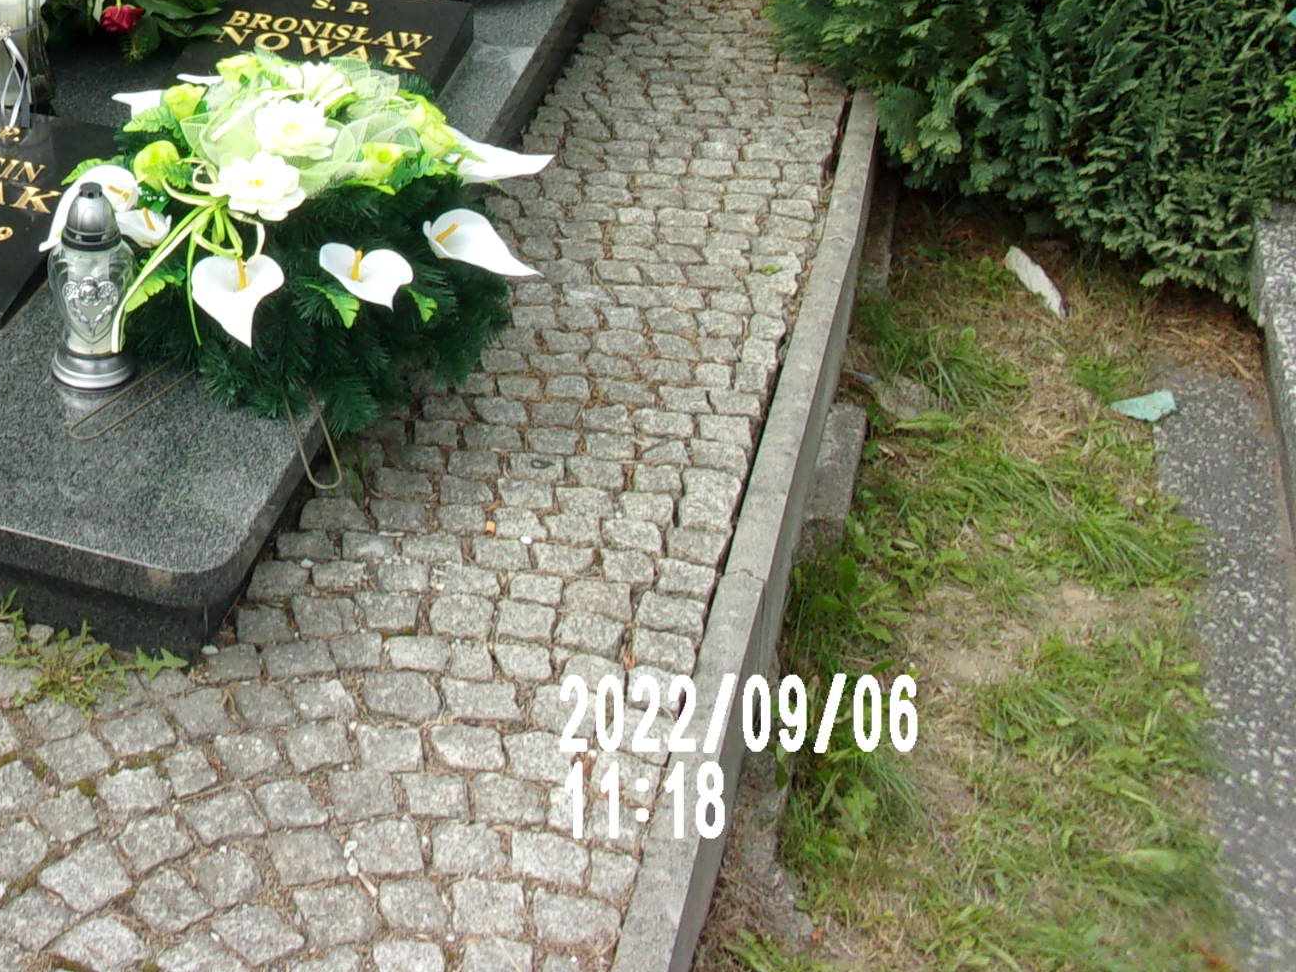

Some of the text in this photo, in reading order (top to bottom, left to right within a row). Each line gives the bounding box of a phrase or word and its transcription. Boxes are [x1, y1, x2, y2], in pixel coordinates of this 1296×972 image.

[346, 1, 370, 15] P.
[214, 26, 422, 70] NOWAK
[226, 10, 433, 50] BRONISŁAW
